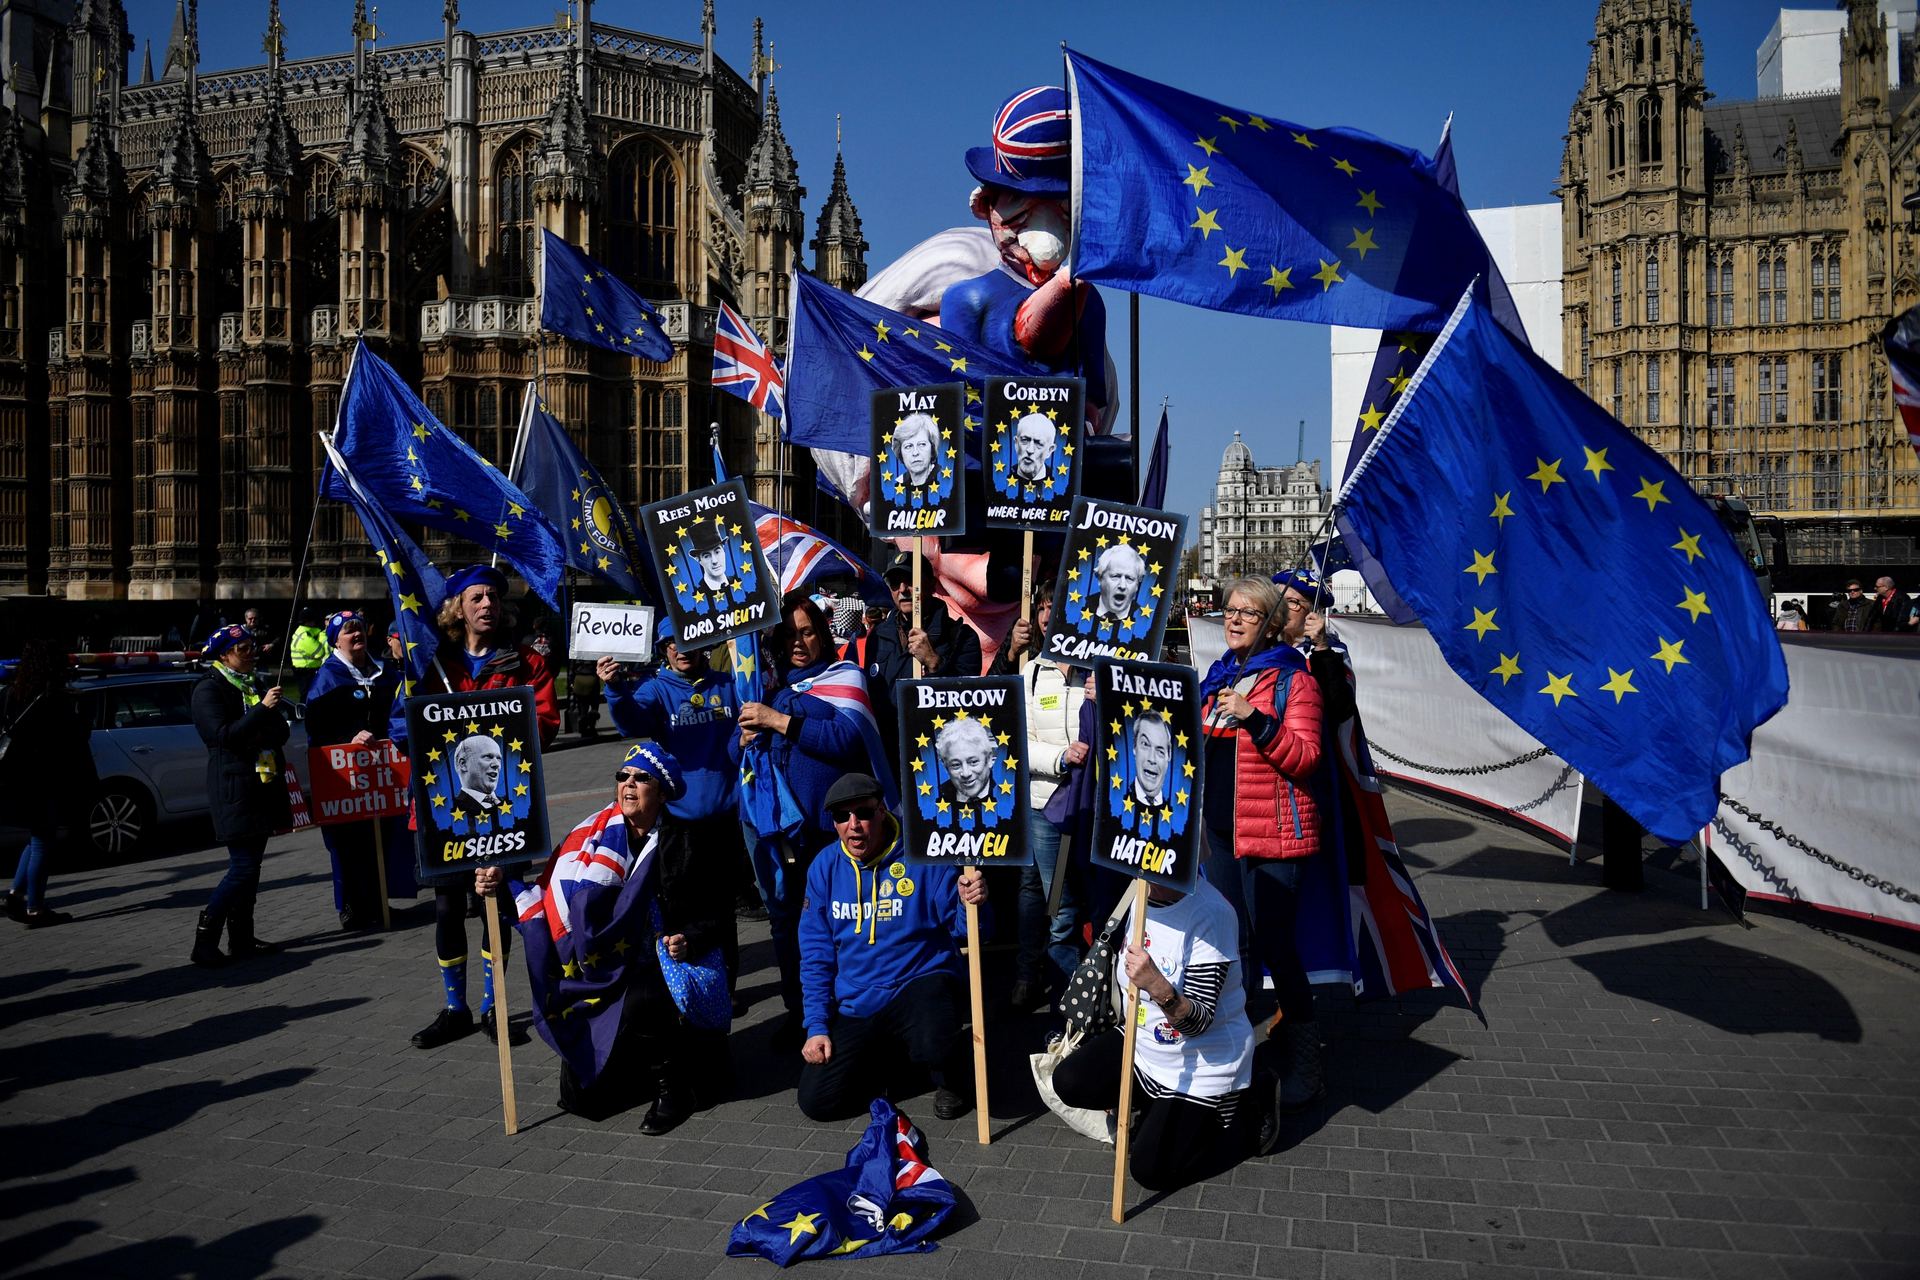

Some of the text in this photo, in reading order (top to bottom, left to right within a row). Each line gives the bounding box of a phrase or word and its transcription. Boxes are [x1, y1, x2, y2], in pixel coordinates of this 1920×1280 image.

[898, 391, 938, 412] MAY
[1003, 381, 1069, 403] CORBYN
[656, 491, 737, 525] REES MOGG
[887, 508, 947, 531] FAILEUR
[987, 505, 1071, 522] WHERE WERE EU?
[1076, 501, 1178, 542] JOHNSON
[584, 499, 617, 550] TIME FOR
[576, 610, 643, 637] Revoke
[683, 601, 766, 641] LORD SNEUTY
[1109, 664, 1184, 701] FARAGE
[916, 685, 1007, 709] BERCOW
[423, 699, 523, 723] GRAYLING
[349, 766, 394, 791] is it
[321, 790, 387, 817] worth
[443, 830, 526, 862] EUSELESS
[926, 831, 1009, 858] BRAVEU
[1110, 834, 1177, 876] HATEUR
